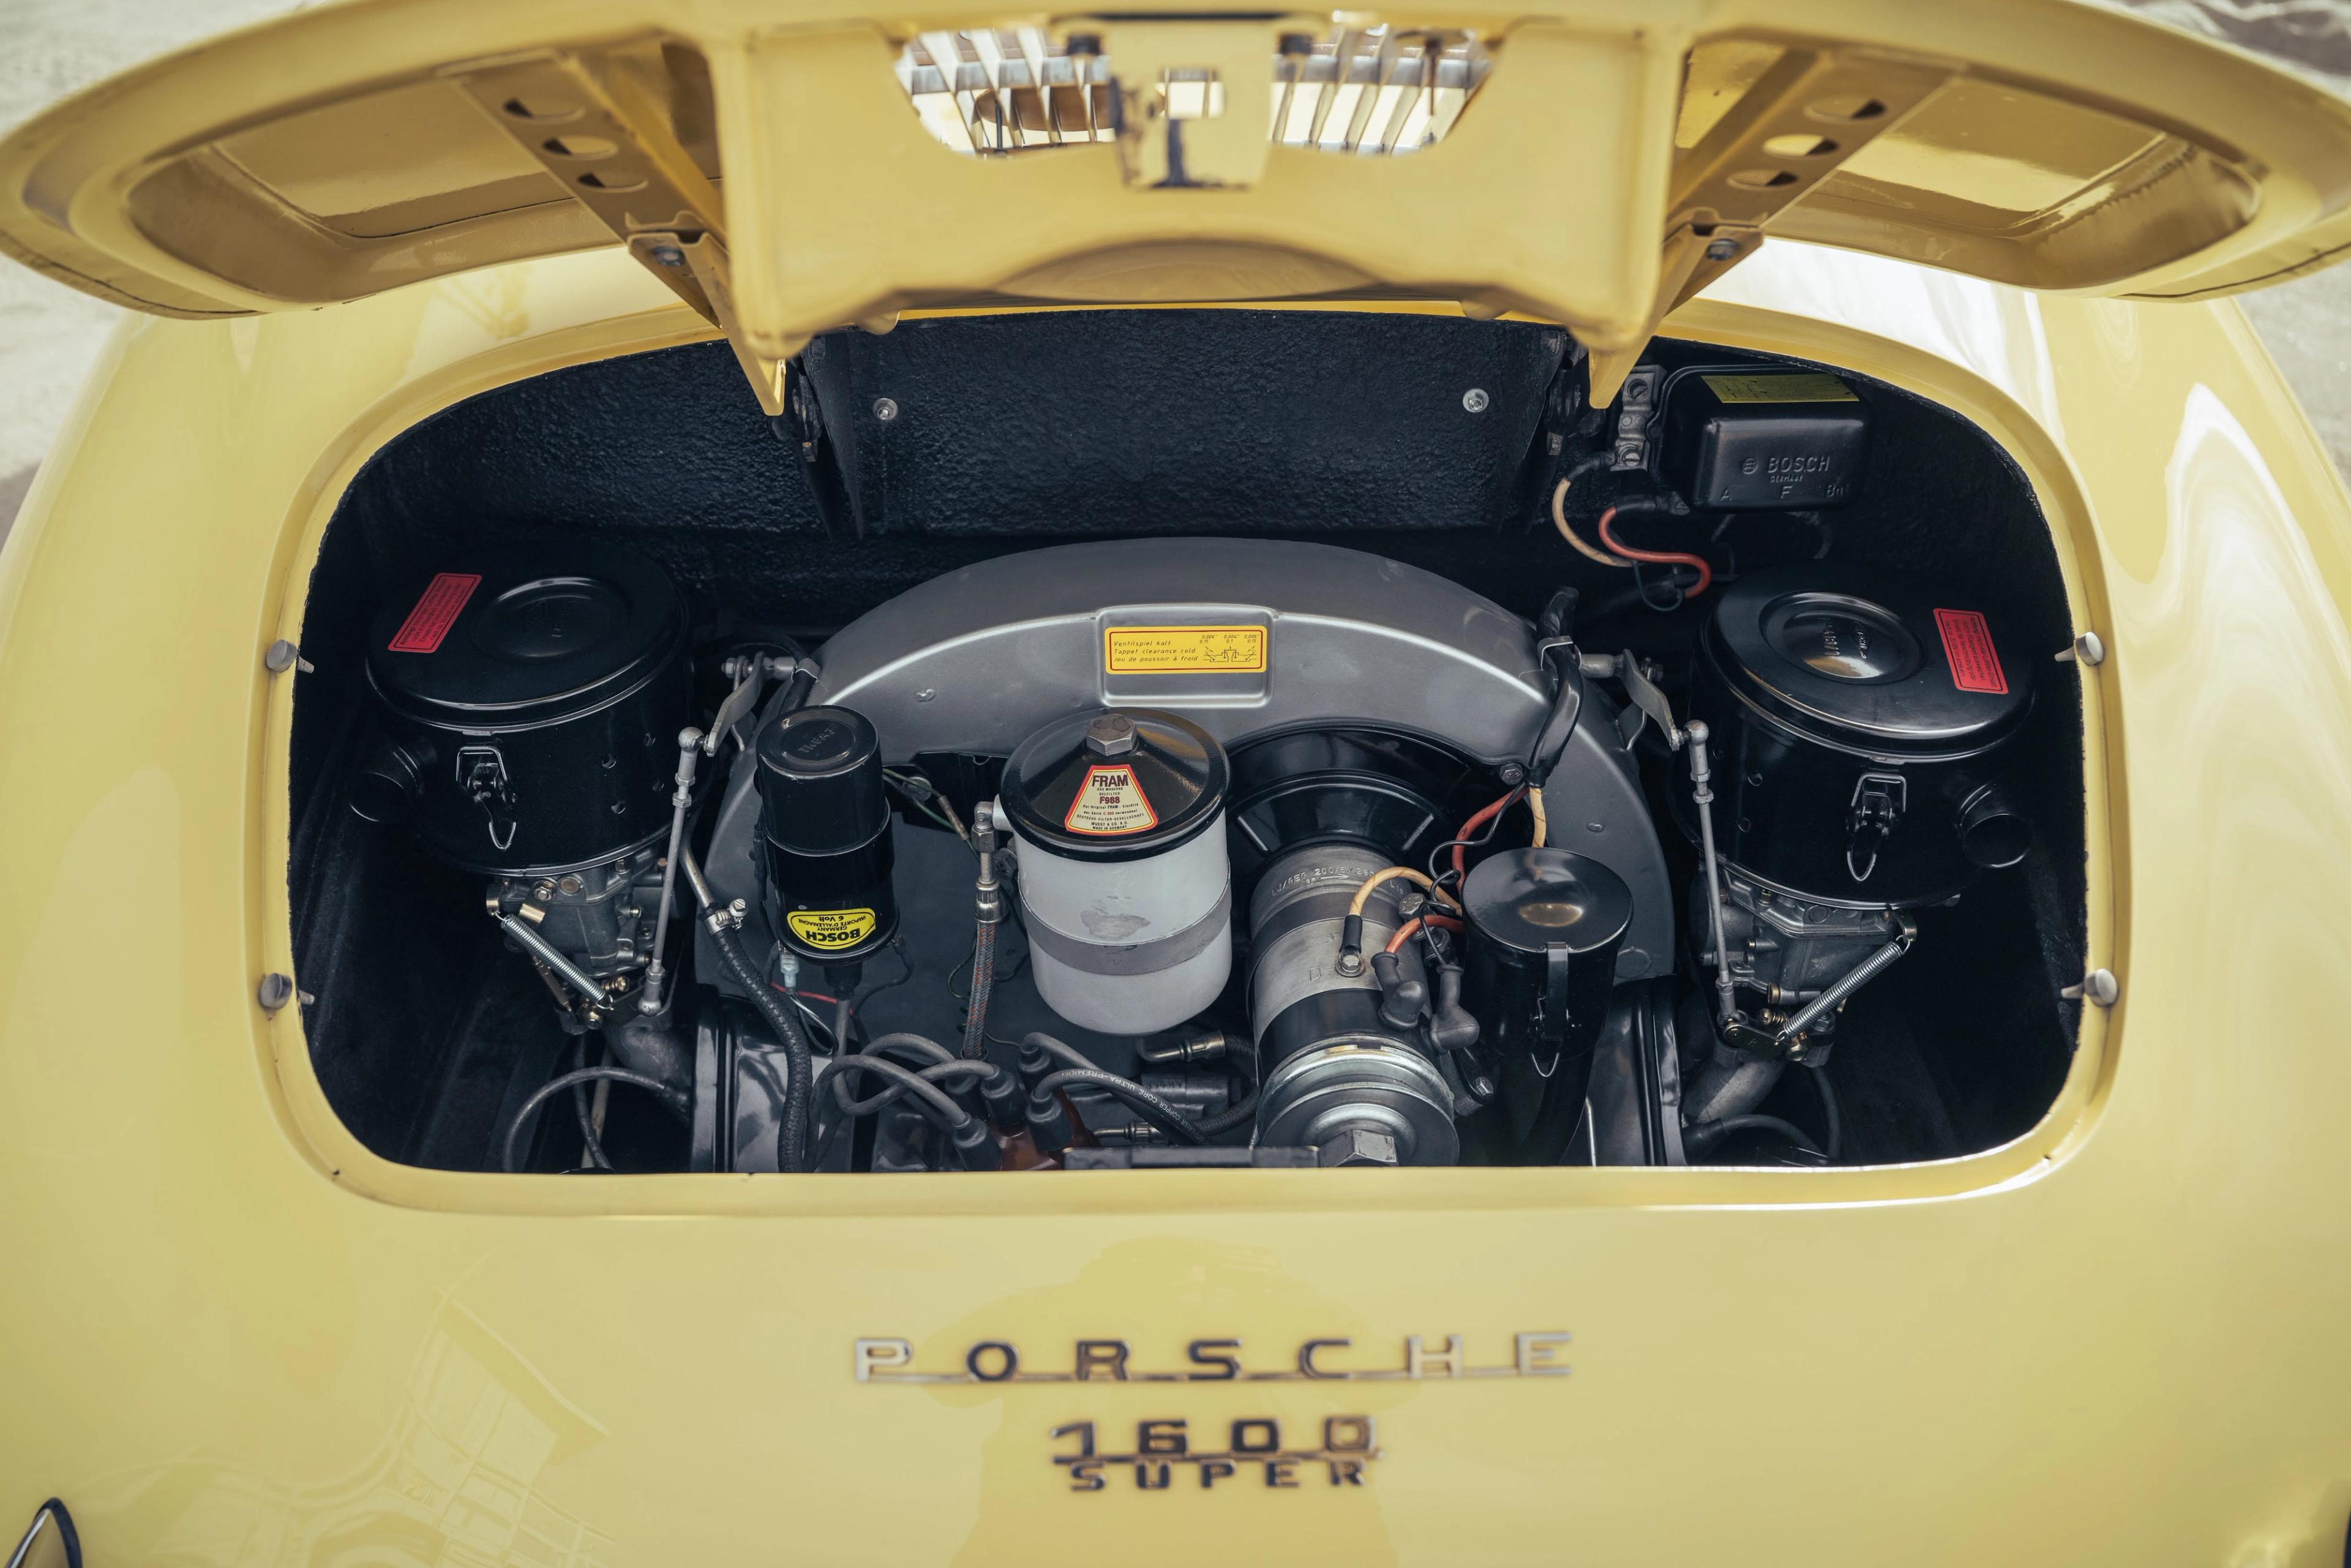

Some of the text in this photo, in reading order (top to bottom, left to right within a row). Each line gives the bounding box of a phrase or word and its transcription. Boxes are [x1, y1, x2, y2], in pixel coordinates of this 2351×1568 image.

[1768, 456, 1830, 473] BOSCH
[1780, 486, 1793, 499] F
[1092, 775, 1128, 787] FRAM
[798, 915, 866, 928] IMPORTE D'ALLEMAGNE
[806, 928, 861, 942] BOSCH
[1061, 1070, 1136, 1090] ULTRA-PREMIUM
[1138, 1089, 1158, 1103] CORE
[1158, 1101, 1181, 1120] COPPER
[856, 1332, 1572, 1382] PORSCHE
[1051, 1415, 1376, 1460] 1600
[1070, 1458, 1366, 1493] SUPER
